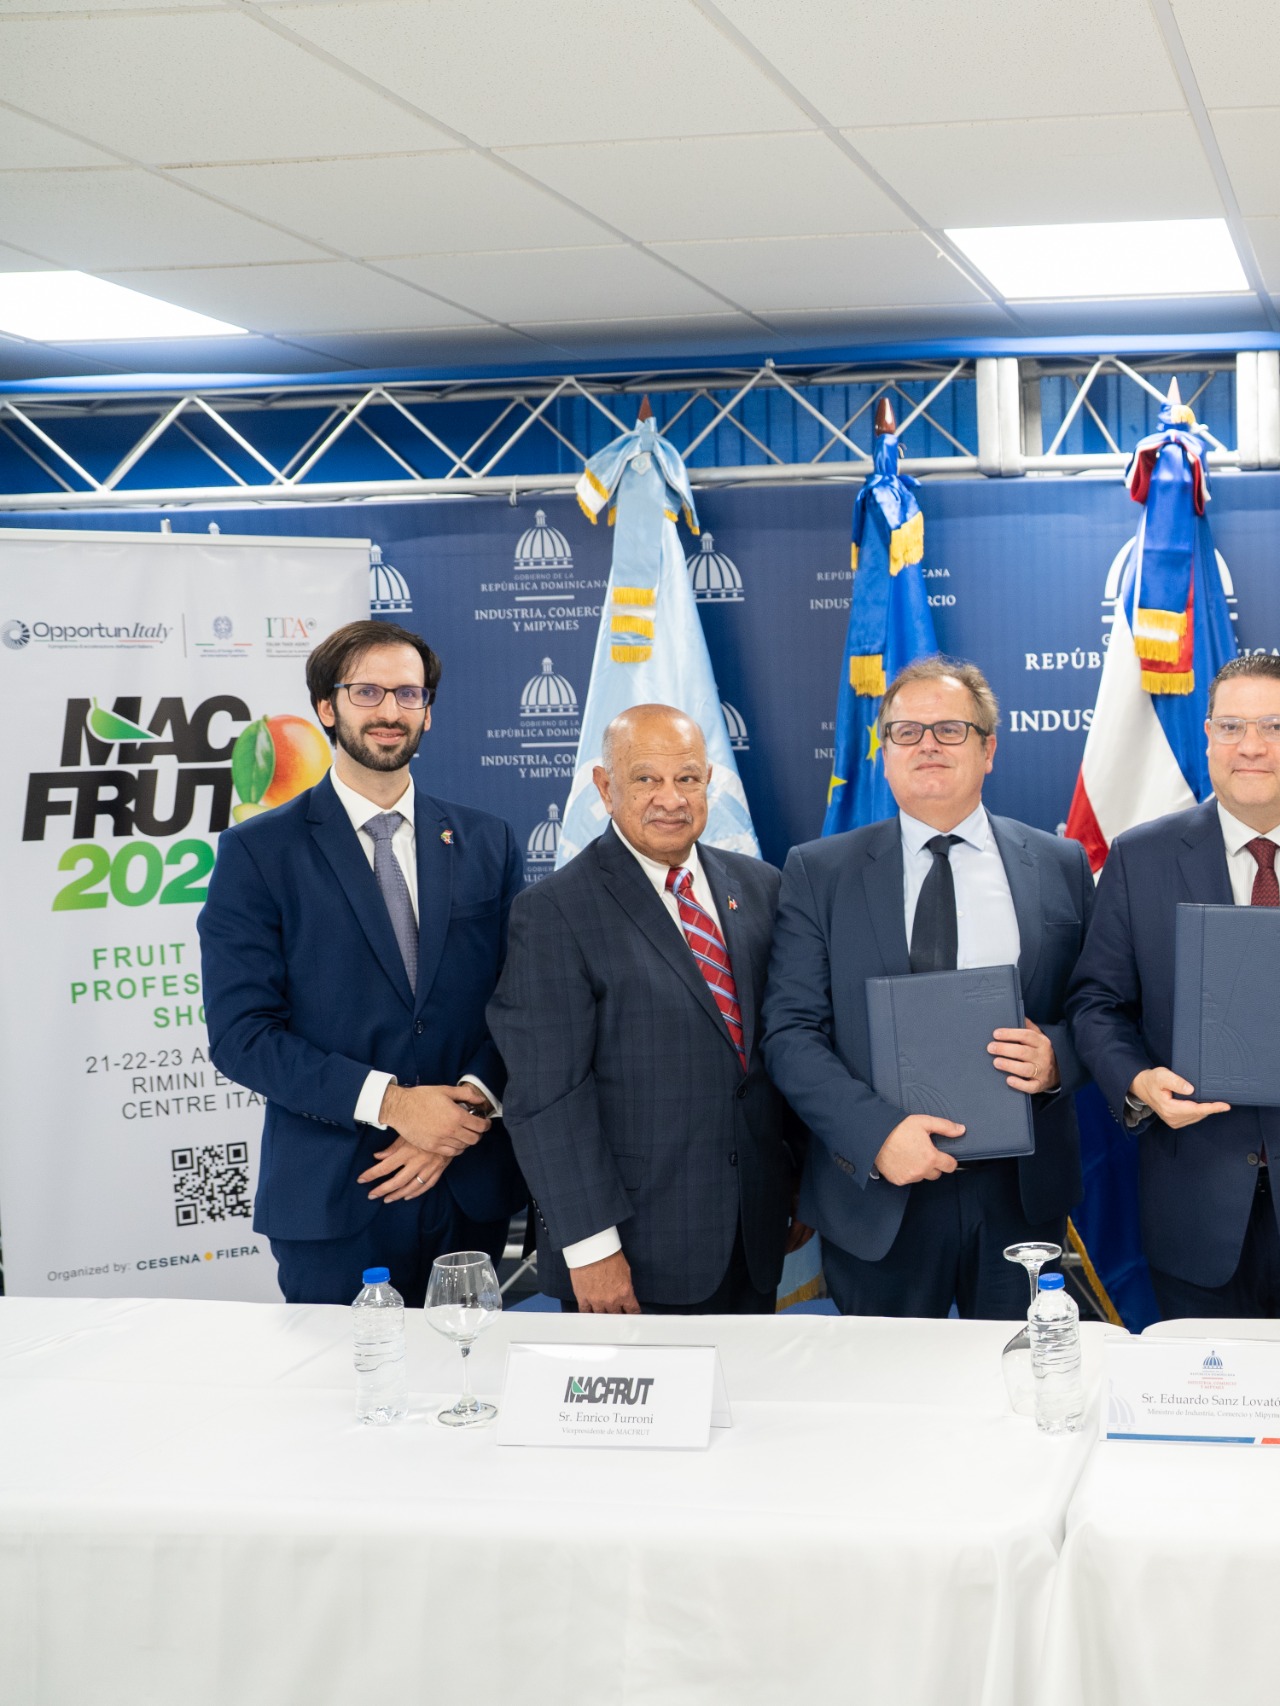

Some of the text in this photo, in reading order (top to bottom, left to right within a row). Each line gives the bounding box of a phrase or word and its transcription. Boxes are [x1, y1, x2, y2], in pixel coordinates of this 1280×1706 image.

[481, 580, 608, 592] REPÚBLICA DOMINICANA
[816, 570, 854, 581] REPÚB
[474, 608, 547, 620] INDUSTRIA,
[33, 622, 173, 643] OpportunItaly
[265, 617, 309, 638] ITA
[513, 620, 579, 632] Y MIPYMES
[1024, 647, 1103, 671] REPÚB
[60, 694, 252, 767] MAC
[1009, 708, 1094, 732] INDUS
[486, 728, 580, 738] REPÚBLICA DOMIN
[481, 755, 552, 766] INDUSTRIA,
[519, 767, 575, 778] Y MIPYM
[22, 767, 234, 841] FRUT
[51, 839, 215, 911] 202
[92, 943, 185, 970] FRUIT
[70, 973, 200, 1004] PROFES
[85, 1048, 183, 1074] 21-22-23
[132, 1071, 205, 1094] RIMINI
[121, 1094, 217, 1120] CENTRE
[47, 1245, 260, 1281] Organized by: CESENA FIERA
[564, 1376, 655, 1405] MACFRUT
[1141, 1393, 1157, 1404] Sr.
[1160, 1393, 1209, 1405] Eduardo
[1211, 1395, 1239, 1406] Sanz
[559, 1411, 654, 1424] Sr. Enrico Turroni
